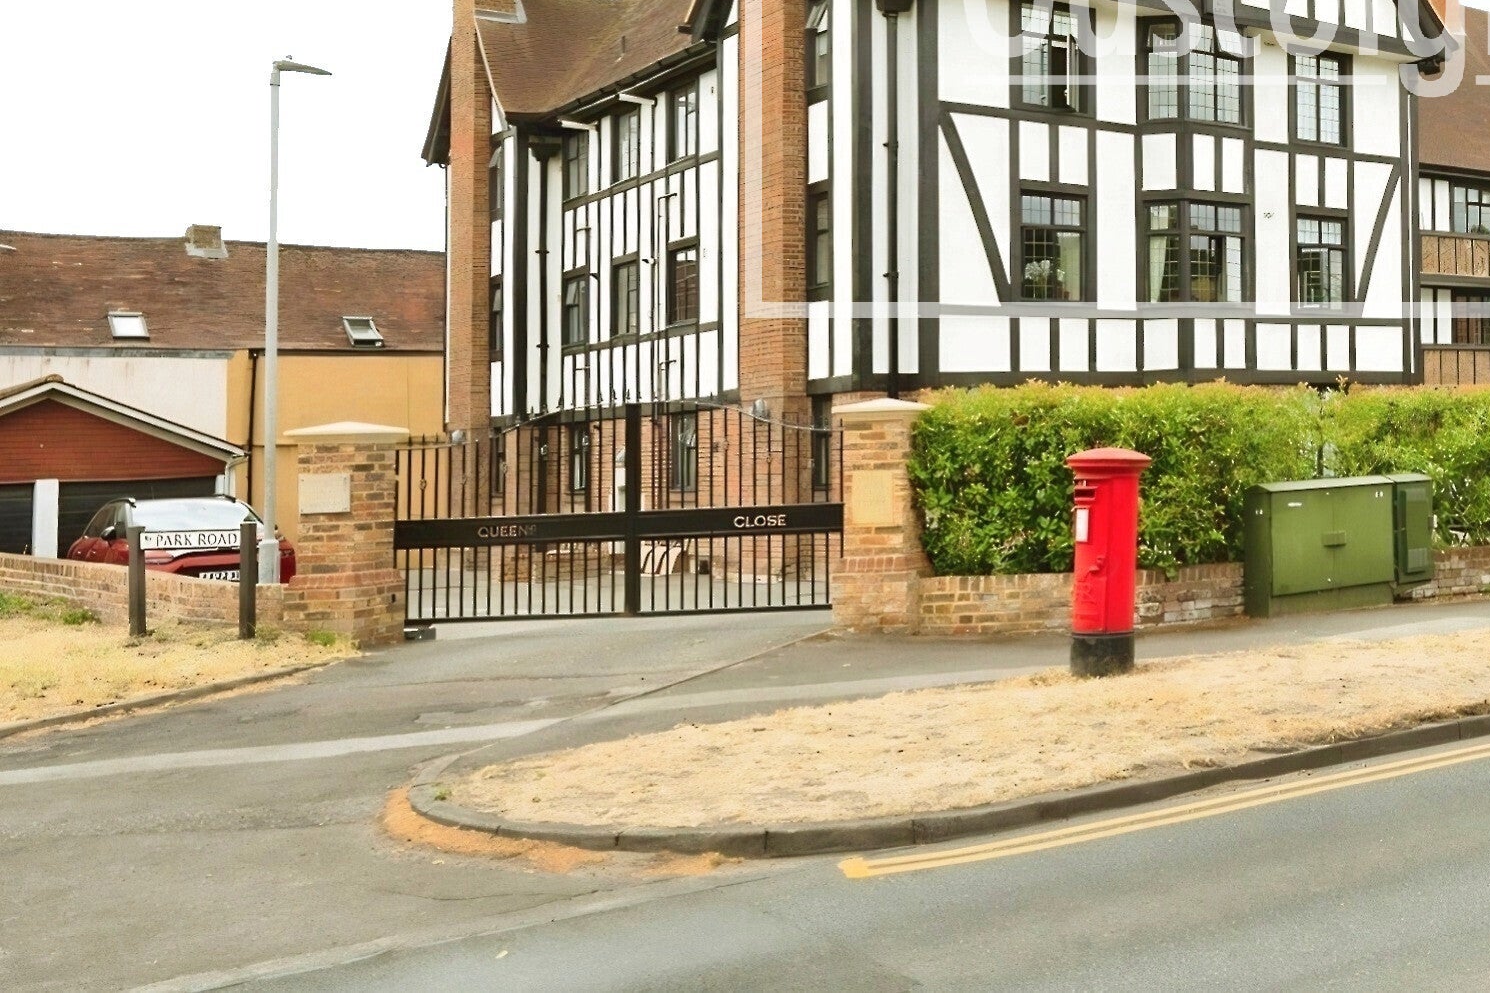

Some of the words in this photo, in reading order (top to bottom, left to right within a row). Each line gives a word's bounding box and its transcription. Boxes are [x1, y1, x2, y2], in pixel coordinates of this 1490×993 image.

[733, 514, 787, 528] CLOSE
[156, 533, 192, 547] PARK
[198, 533, 237, 546] ROAD
